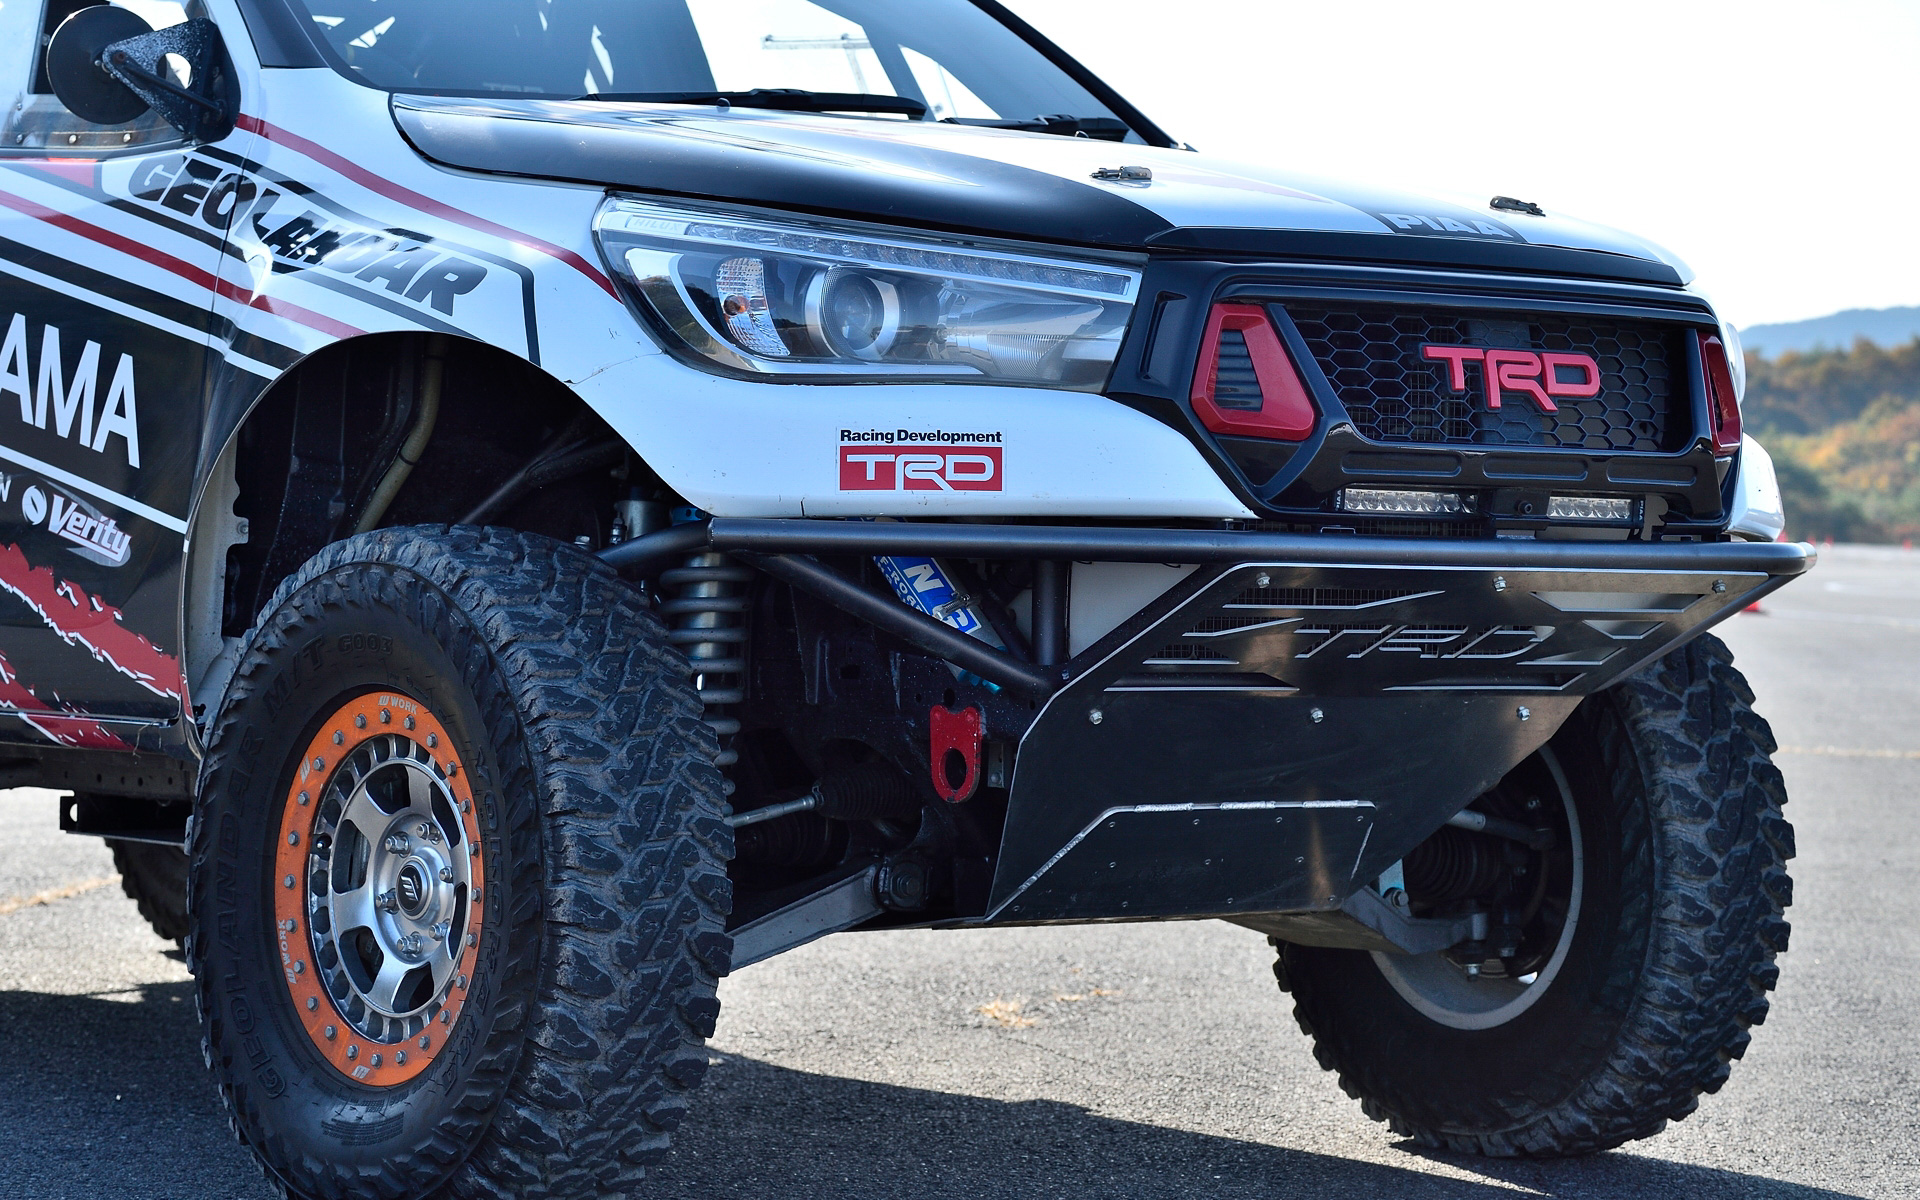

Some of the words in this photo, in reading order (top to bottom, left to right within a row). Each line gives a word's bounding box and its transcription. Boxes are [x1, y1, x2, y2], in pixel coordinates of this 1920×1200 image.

[128, 155, 487, 317] GEOLANDAR
[1379, 212, 1513, 238] PIAA
[1422, 345, 1600, 412] TRD
[840, 429, 895, 444] Racing
[897, 429, 1002, 444] Development
[846, 453, 995, 491] TRD
[48, 494, 132, 562] Verity
[1294, 624, 1556, 659] TRD
[391, 696, 416, 714] WORK
[278, 919, 290, 966] WORK
